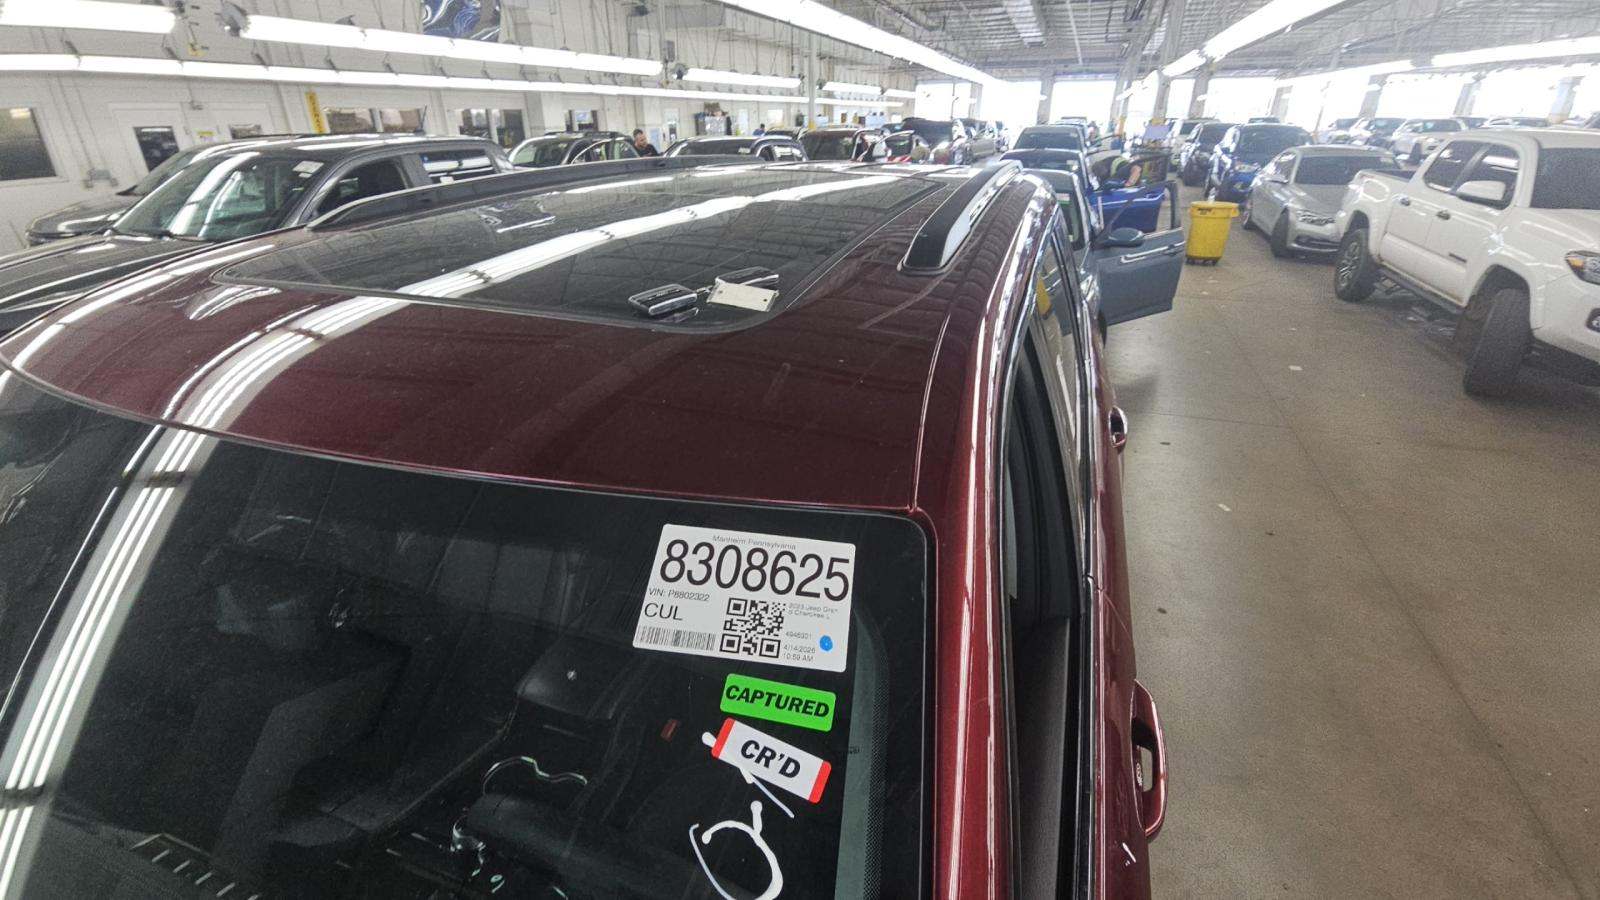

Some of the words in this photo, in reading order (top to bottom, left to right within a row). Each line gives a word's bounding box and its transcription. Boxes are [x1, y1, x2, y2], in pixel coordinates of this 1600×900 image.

[712, 535, 746, 545] Manheim
[748, 538, 796, 550] Pennsylvania
[660, 539, 850, 602] 8308625
[648, 587, 667, 598] VIN:
[668, 589, 710, 602] P8802322
[644, 602, 683, 621] CUL
[802, 653, 814, 662] AM
[725, 684, 830, 718] CAPTURED
[740, 739, 801, 779] CR'D
